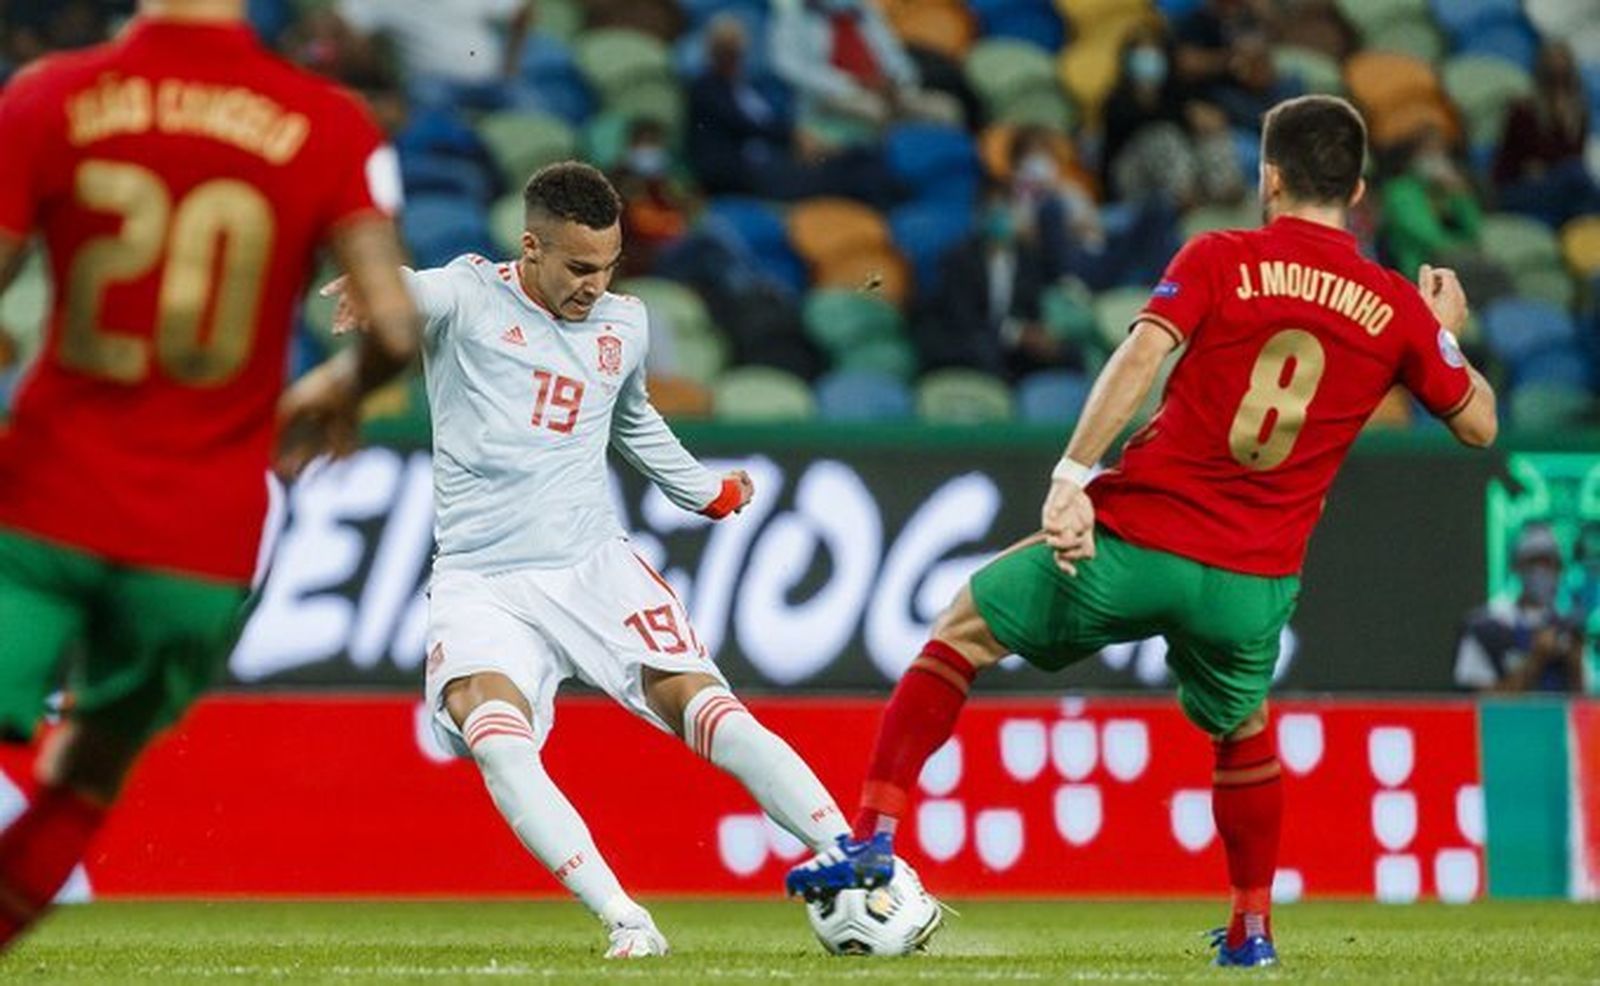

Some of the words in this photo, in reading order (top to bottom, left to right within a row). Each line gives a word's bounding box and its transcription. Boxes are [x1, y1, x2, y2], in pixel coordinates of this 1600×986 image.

[61, 158, 276, 386] 20
[1236, 263, 1259, 299] J.
[1260, 261, 1394, 336] MOUTINHO
[531, 369, 584, 434] 19
[1228, 328, 1326, 471] 8
[624, 605, 687, 654] 19
